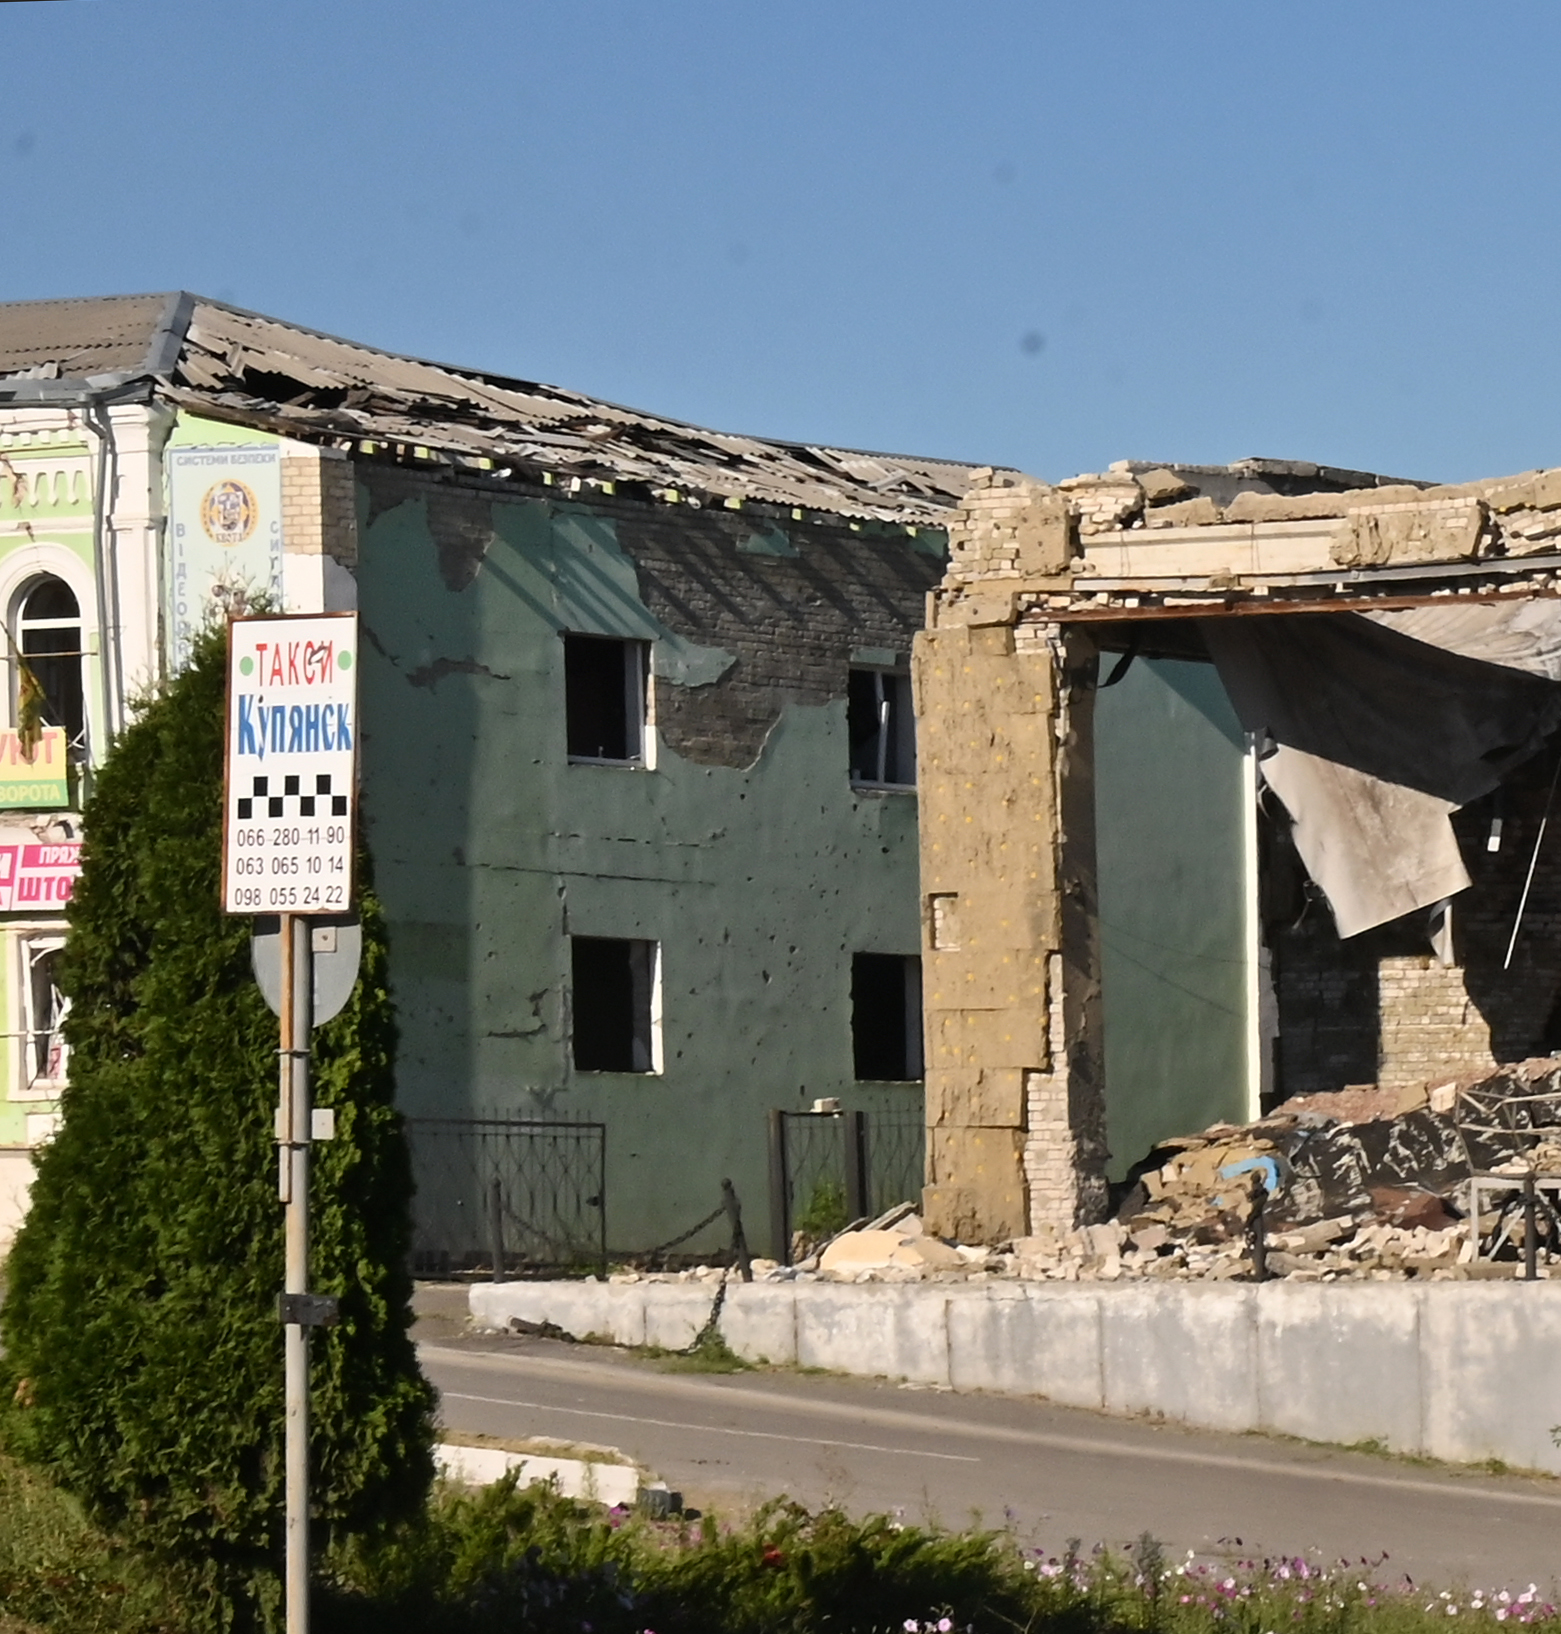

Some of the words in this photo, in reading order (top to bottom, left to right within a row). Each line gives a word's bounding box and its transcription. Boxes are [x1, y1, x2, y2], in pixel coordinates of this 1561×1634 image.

[176, 455, 228, 467] СИСТЕМИ
[230, 453, 276, 465] БЕЗПЕКИ
[255, 640, 333, 687] ТАКСИ
[238, 694, 353, 761] Купянск
[236, 828, 266, 847] 066
[273, 827, 300, 846] 280
[307, 826, 320, 845] 11
[326, 825, 345, 844] 90
[236, 857, 264, 875] 063
[271, 856, 299, 875] 065
[305, 855, 322, 874] 10
[328, 855, 344, 873] 14
[234, 887, 262, 906] 098
[269, 887, 297, 905] 055
[303, 886, 320, 904] 24
[325, 885, 343, 904] 22
